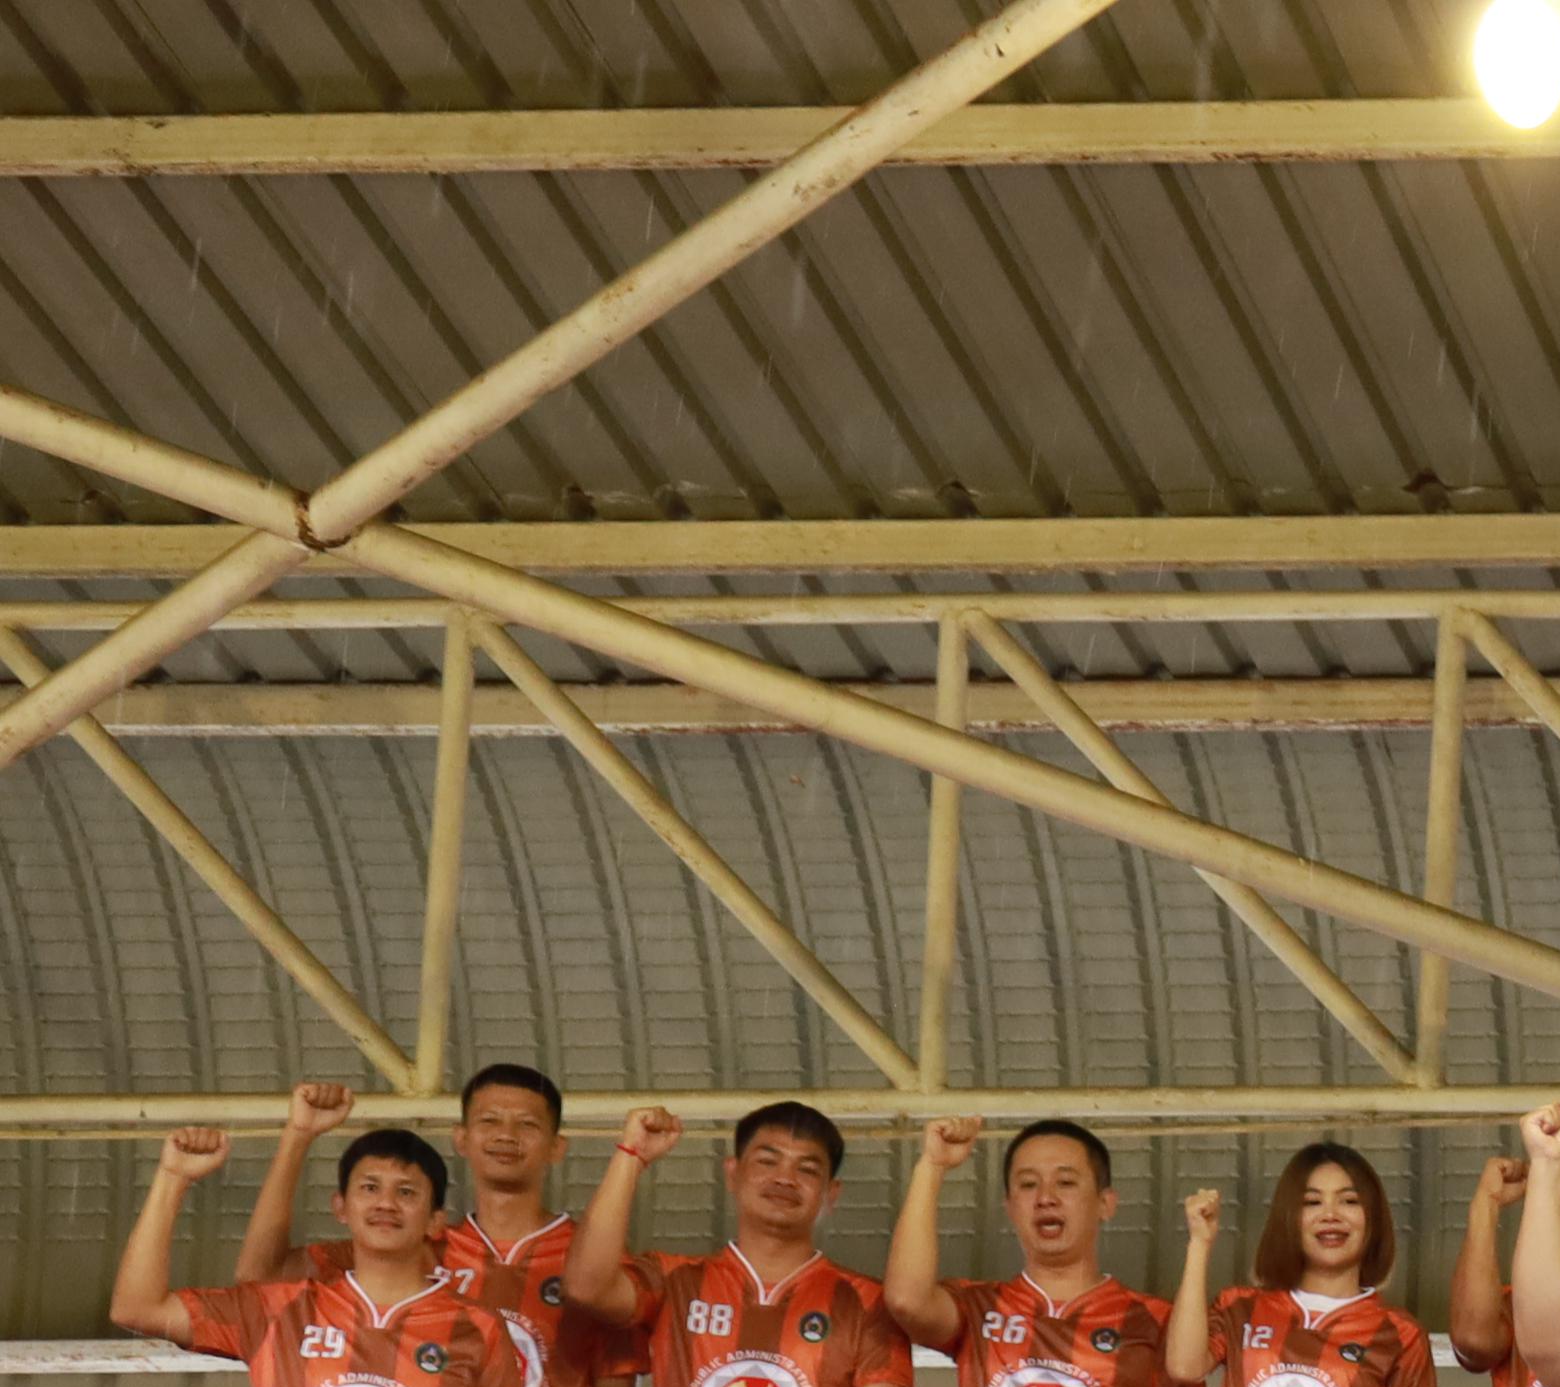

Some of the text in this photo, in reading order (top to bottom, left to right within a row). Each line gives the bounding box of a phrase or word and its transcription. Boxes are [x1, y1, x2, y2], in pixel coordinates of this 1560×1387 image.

[687, 1300, 734, 1337] 88
[981, 1310, 1027, 1344] 26
[300, 1324, 346, 1359] 29
